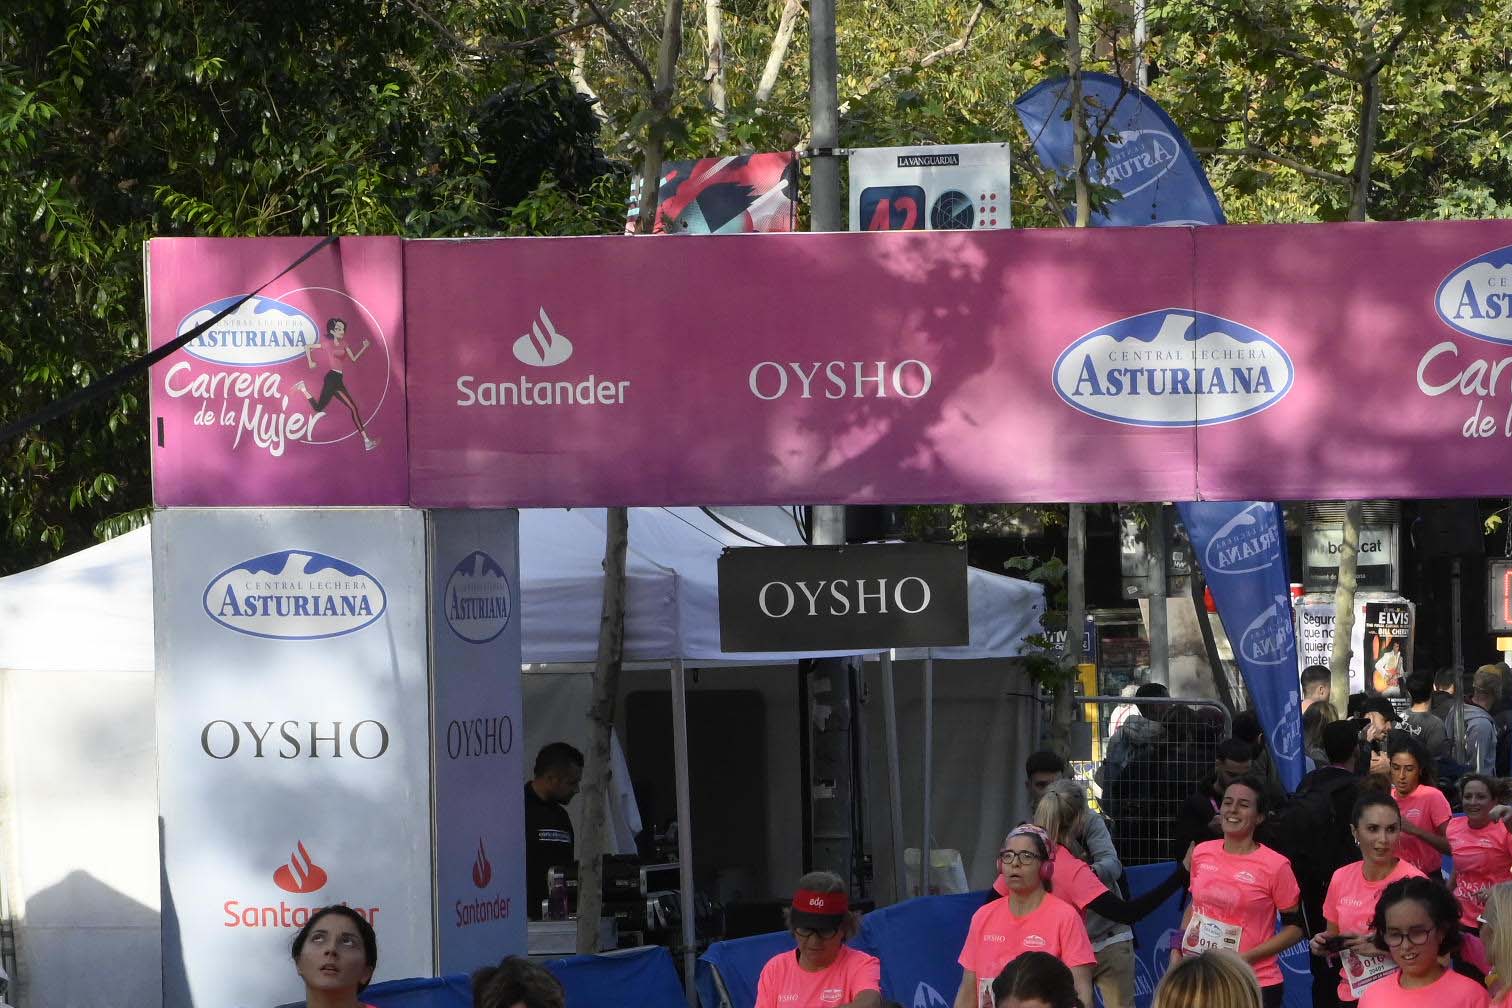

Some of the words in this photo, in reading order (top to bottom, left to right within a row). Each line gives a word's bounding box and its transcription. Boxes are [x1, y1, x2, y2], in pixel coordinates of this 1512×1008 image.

[1108, 349, 1183, 362] CENTRAL
[1193, 348, 1267, 361] LECHERA
[165, 361, 281, 398] Carrera
[457, 374, 630, 407] Santander
[748, 359, 932, 400] OYSHO
[1071, 352, 1275, 397] ASTURIANA
[194, 400, 215, 426] de
[220, 400, 236, 426] la
[233, 392, 327, 457] Mujer
[1462, 400, 1497, 438] de
[217, 583, 374, 618] ASTURIANA
[245, 581, 302, 591] CENTRAL
[309, 580, 367, 590] LECHERA
[759, 576, 931, 618] OYSHO
[1304, 628, 1321, 639] que
[1378, 612, 1409, 624] ELVIS
[201, 719, 389, 760] OYSHO
[447, 715, 513, 760] OYSHO
[456, 896, 511, 929] Santander
